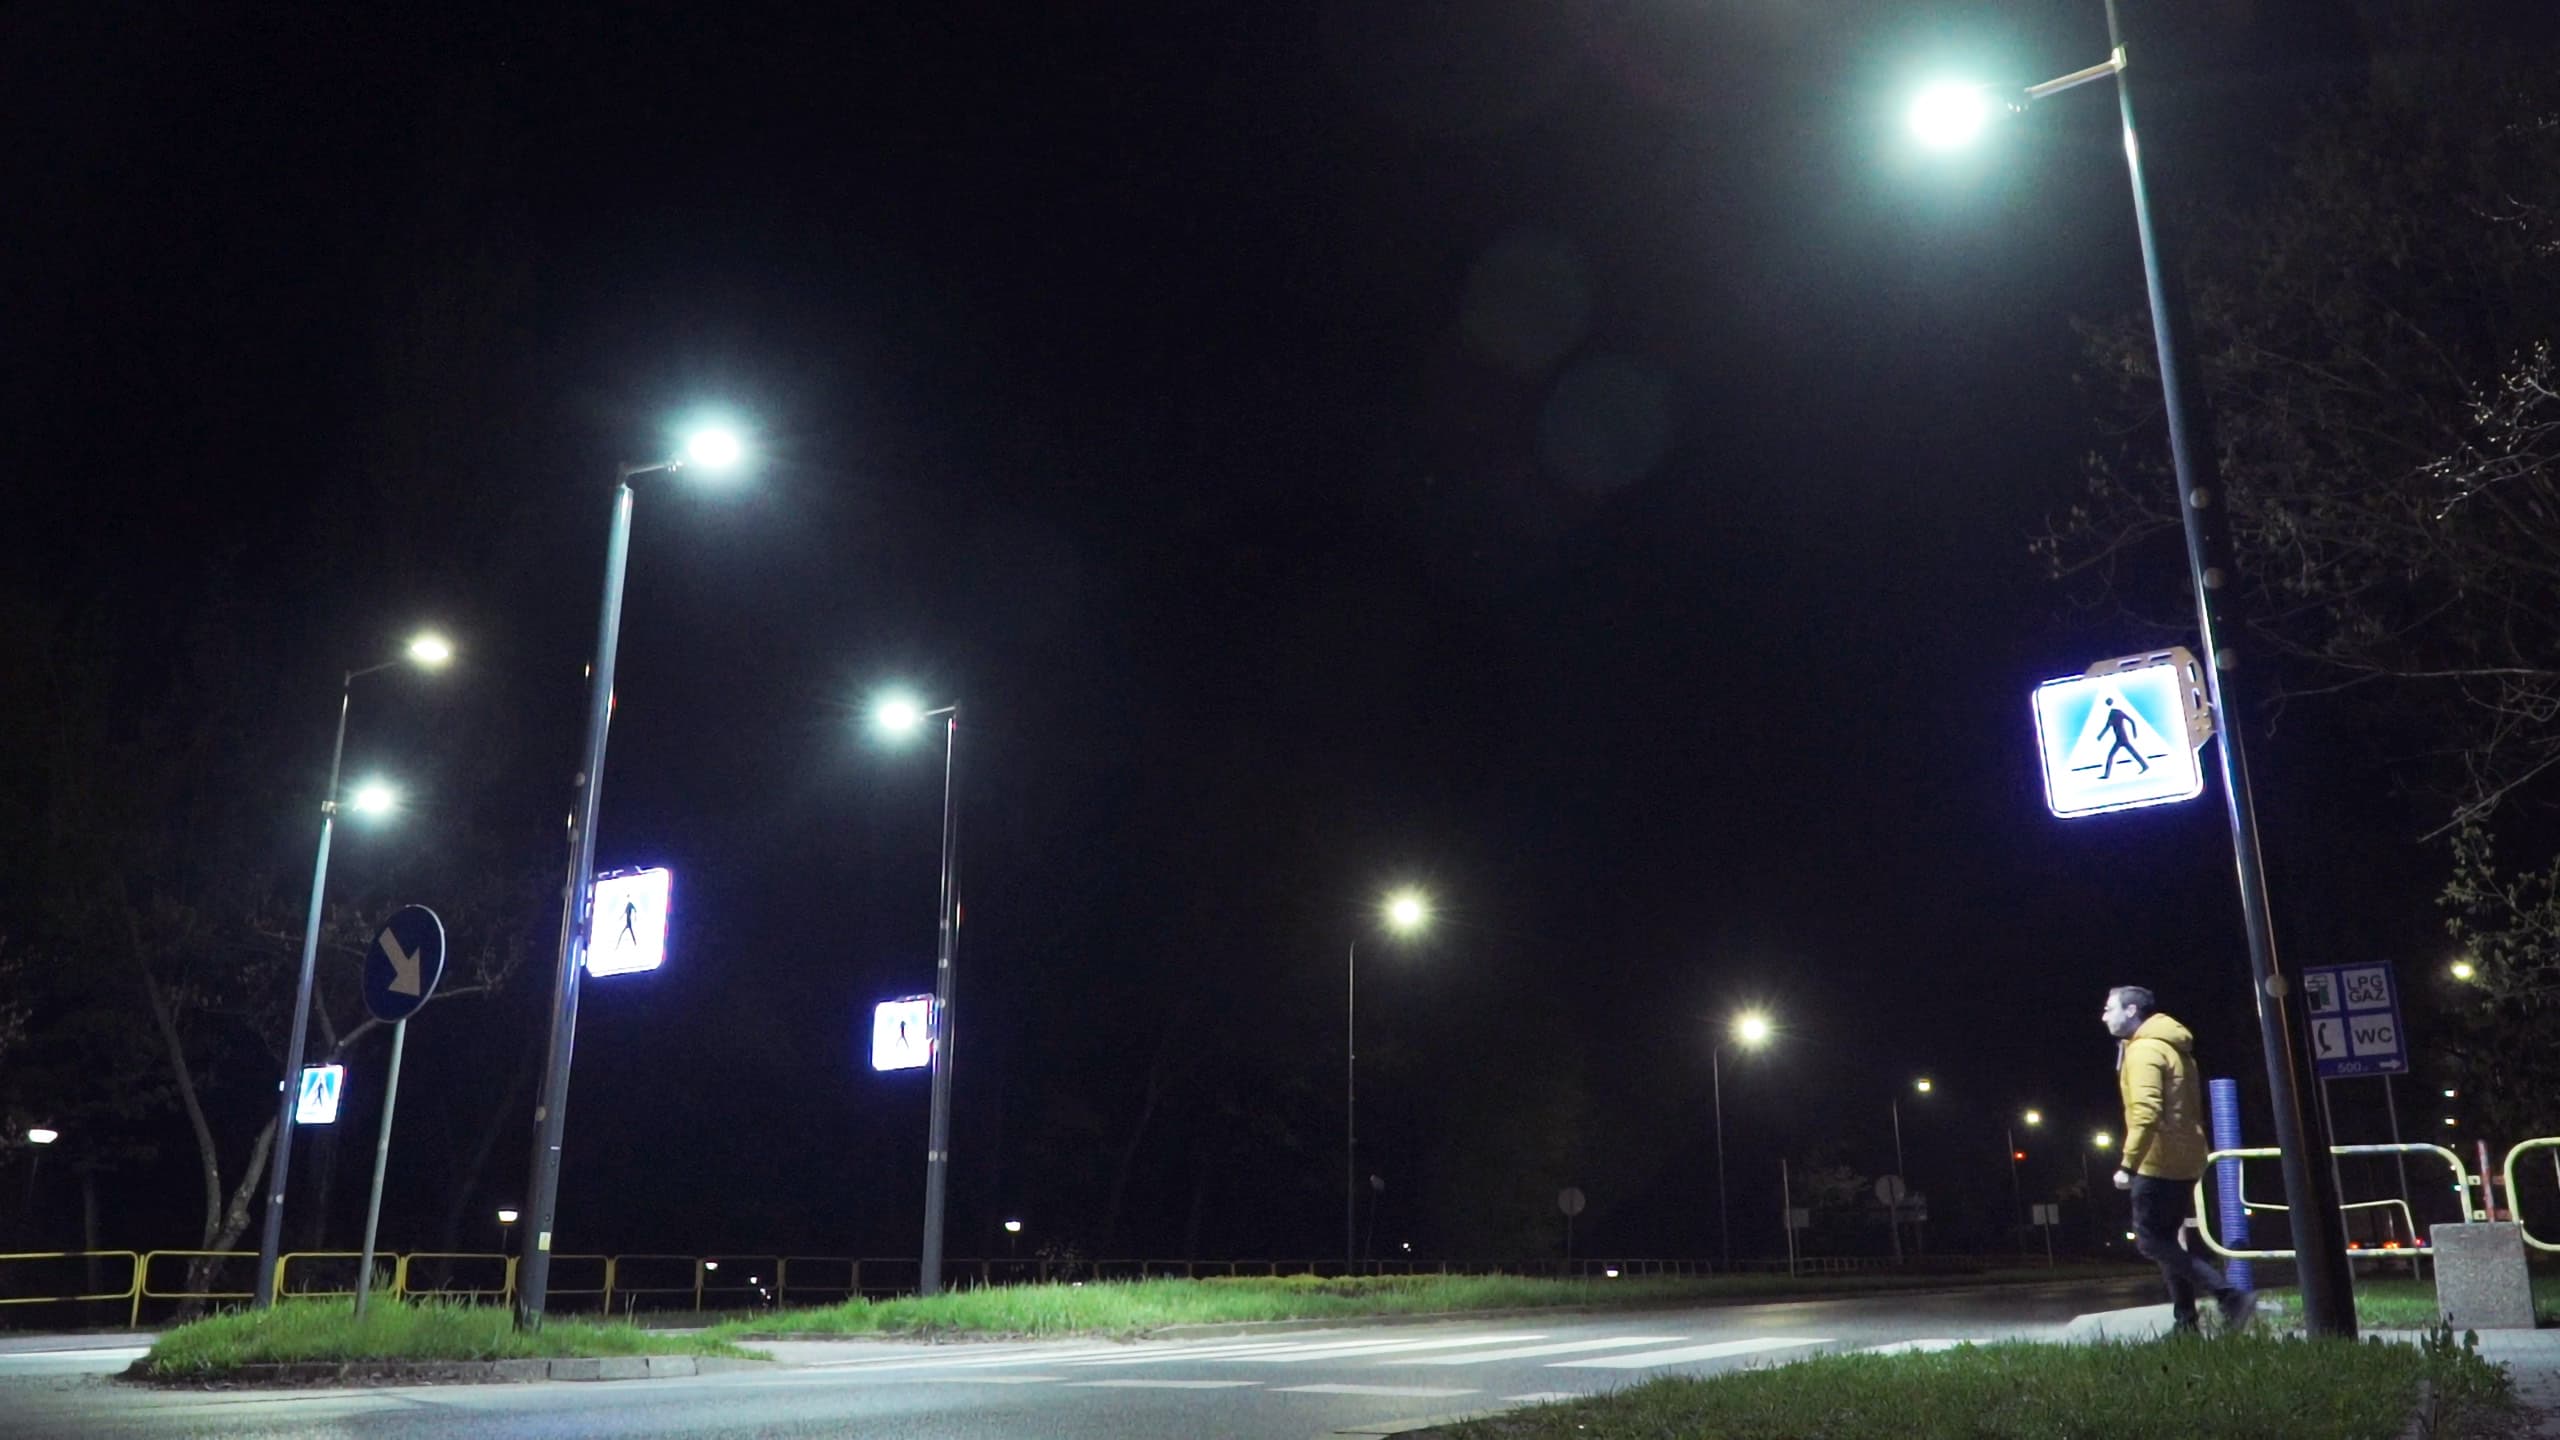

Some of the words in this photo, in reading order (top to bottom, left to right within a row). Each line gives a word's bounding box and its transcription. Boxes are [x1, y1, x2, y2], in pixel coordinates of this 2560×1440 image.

[2347, 975, 2384, 990] LPG
[2349, 988, 2386, 1003] GAZ
[2355, 1027, 2393, 1044] WC
